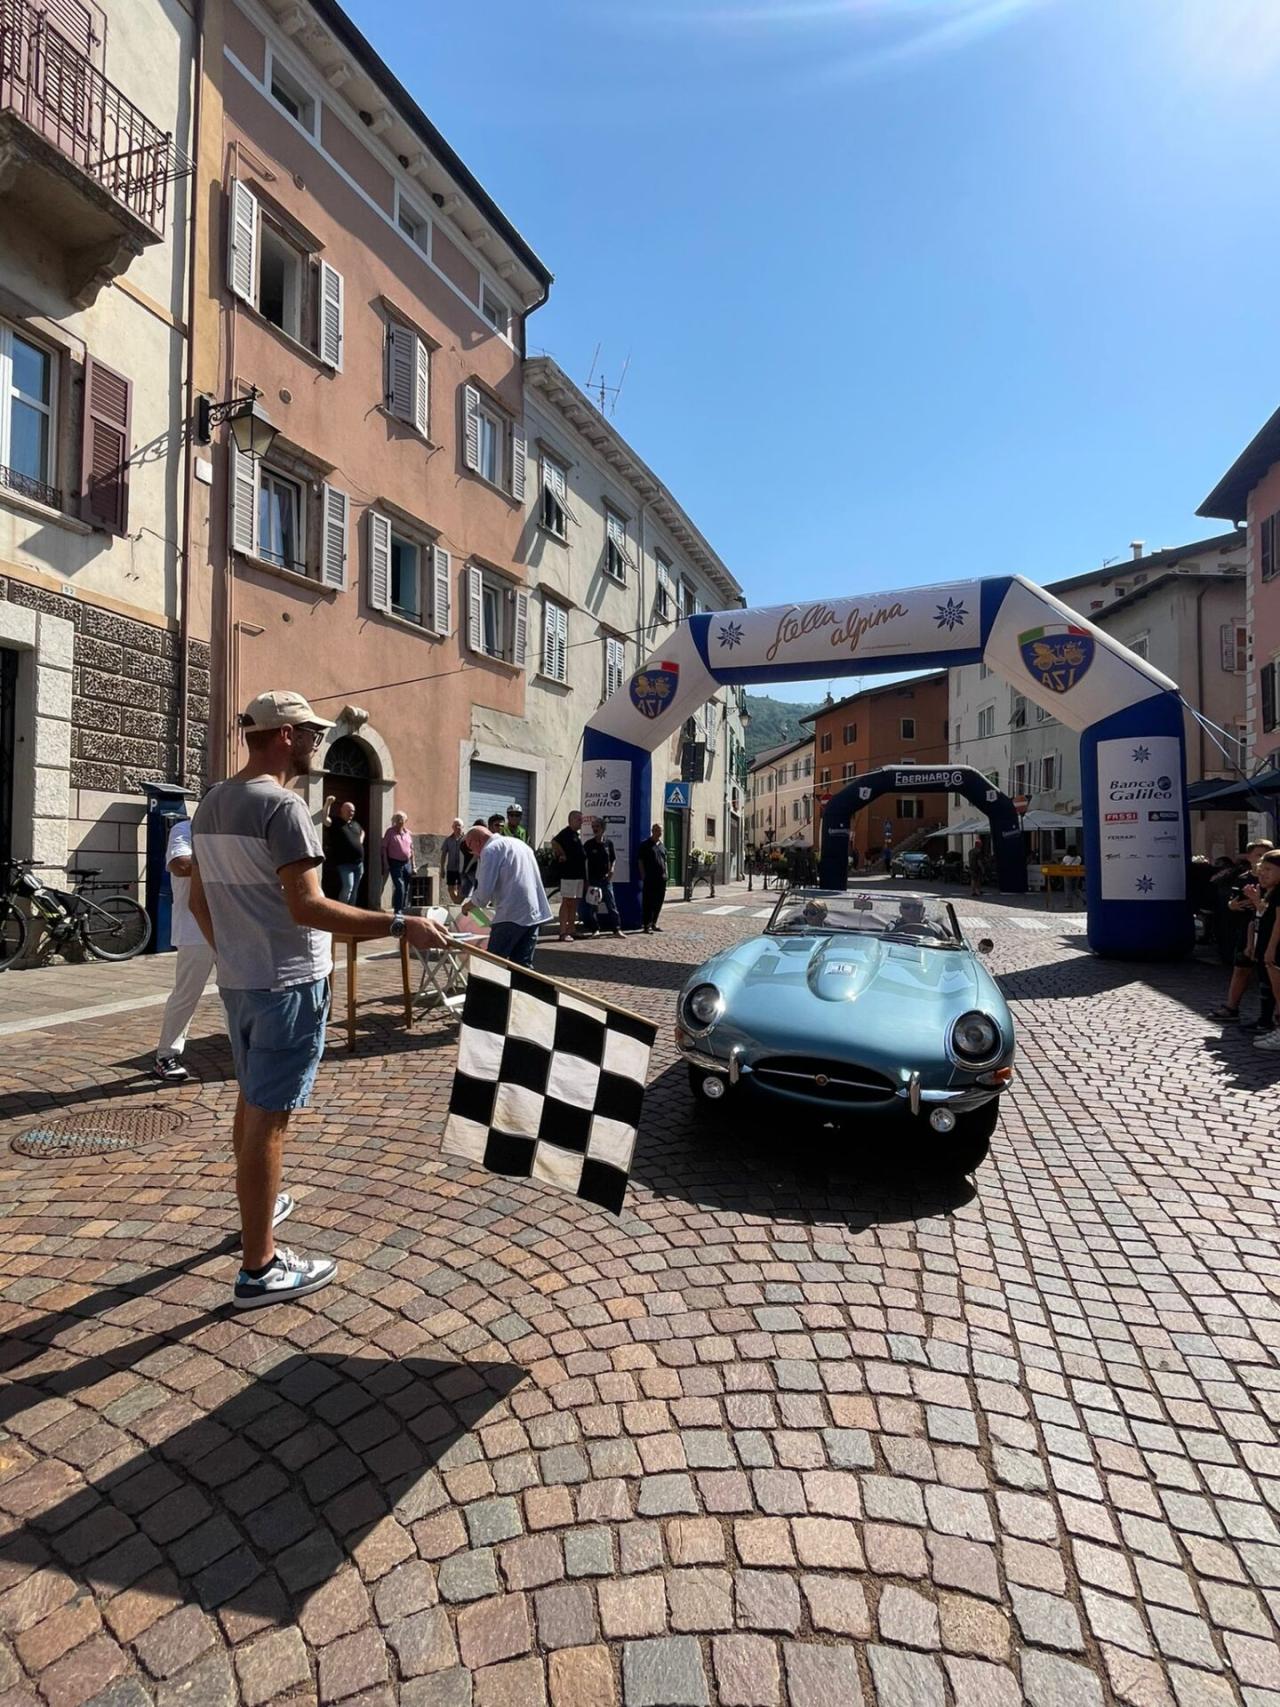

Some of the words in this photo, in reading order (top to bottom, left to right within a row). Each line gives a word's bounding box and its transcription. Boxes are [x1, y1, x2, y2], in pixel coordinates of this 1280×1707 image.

[766, 604, 841, 662] Stella
[830, 602, 909, 652] alpina
[1110, 780, 1156, 790] Banca
[1109, 788, 1173, 802] Galileo
[150, 798, 158, 812] P
[584, 798, 622, 807] Galileo
